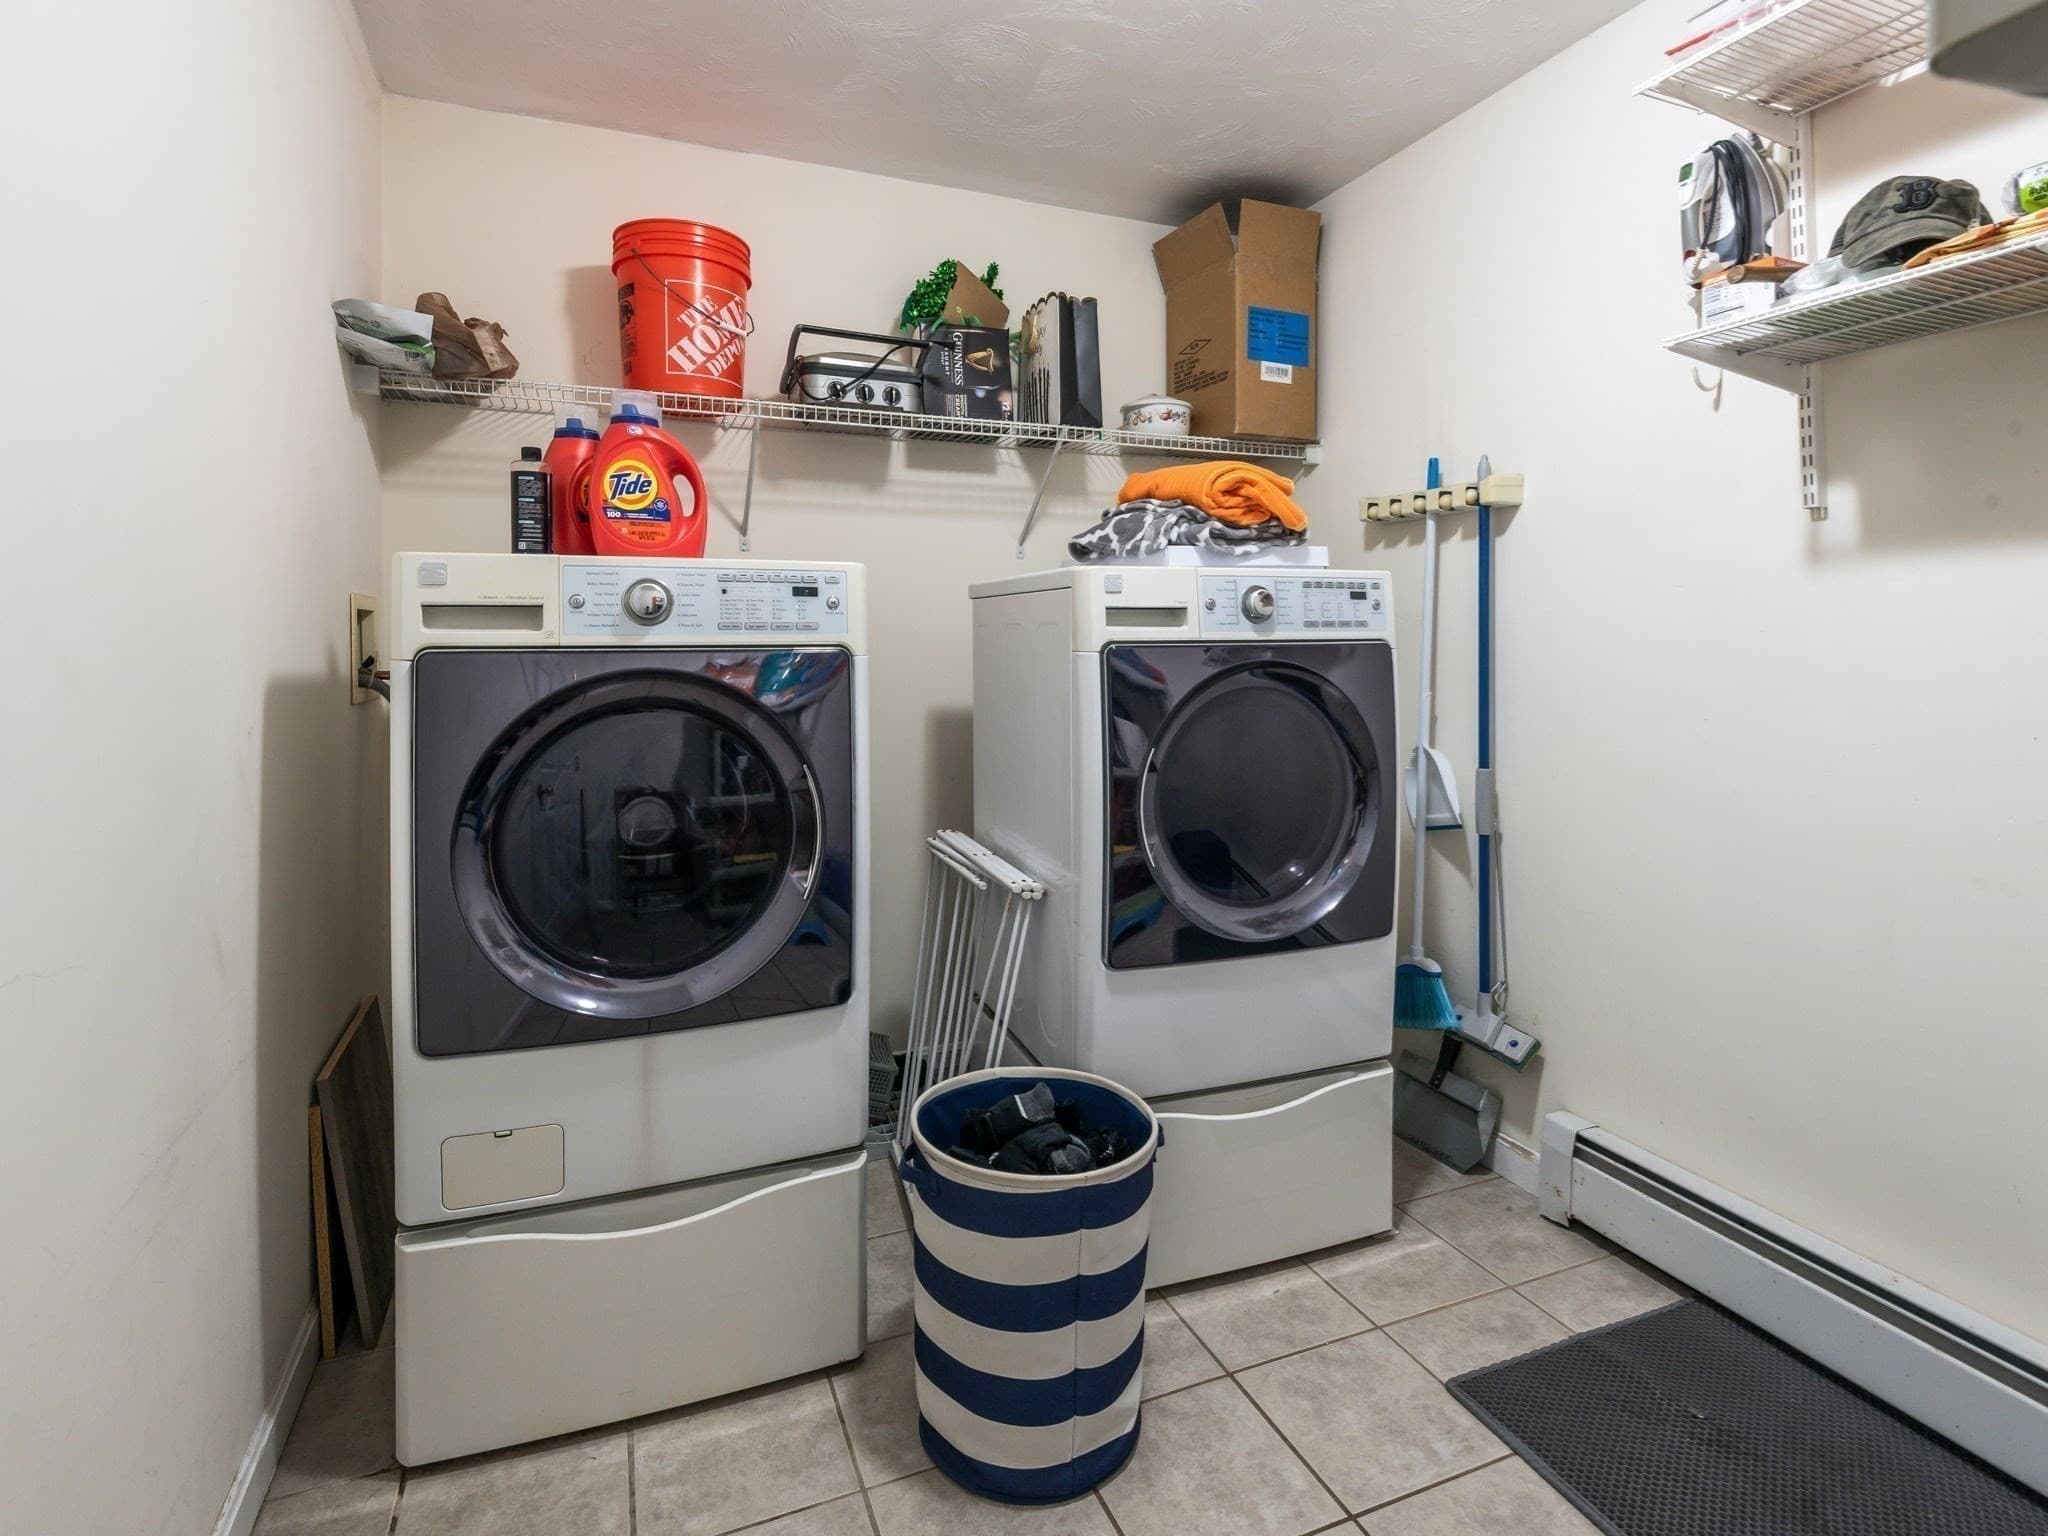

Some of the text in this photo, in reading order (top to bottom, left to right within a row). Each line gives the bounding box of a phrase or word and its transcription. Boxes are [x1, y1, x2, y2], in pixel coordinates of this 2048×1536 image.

[676, 294, 718, 329] THE
[667, 296, 744, 373] HOME
[953, 332, 963, 386] GUINNESS
[609, 472, 653, 500] Tide
